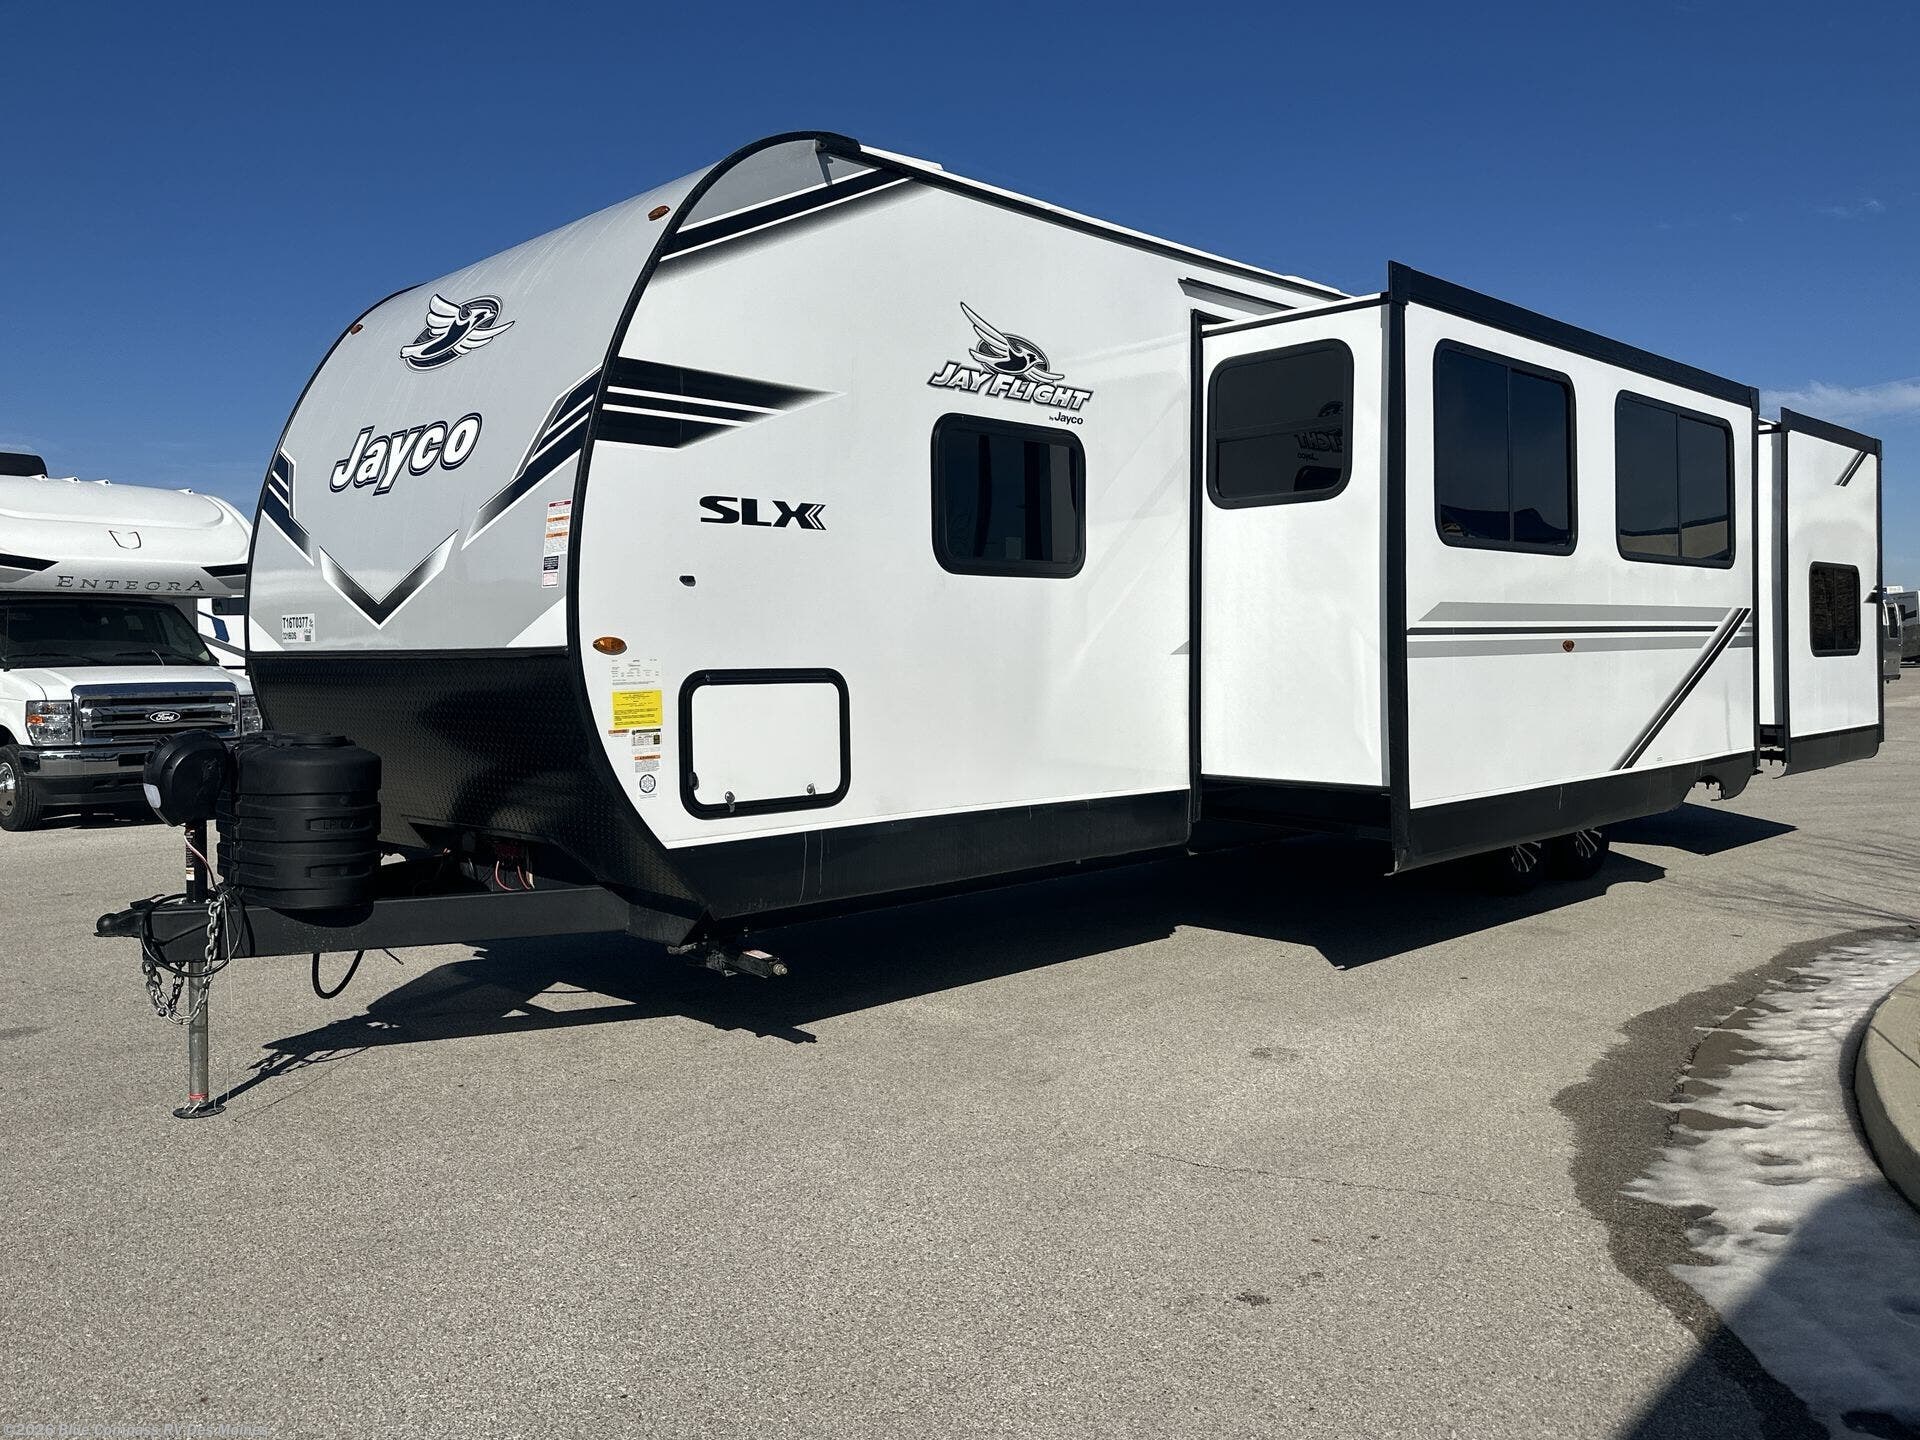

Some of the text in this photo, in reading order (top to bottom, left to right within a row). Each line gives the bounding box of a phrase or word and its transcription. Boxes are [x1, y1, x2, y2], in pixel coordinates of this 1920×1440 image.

[927, 360, 1094, 411] JAY FLIGHT
[1054, 412, 1084, 425] Jayco
[329, 412, 483, 496] Jayco
[700, 495, 827, 531] SLX
[56, 575, 205, 592] ENTEGRA
